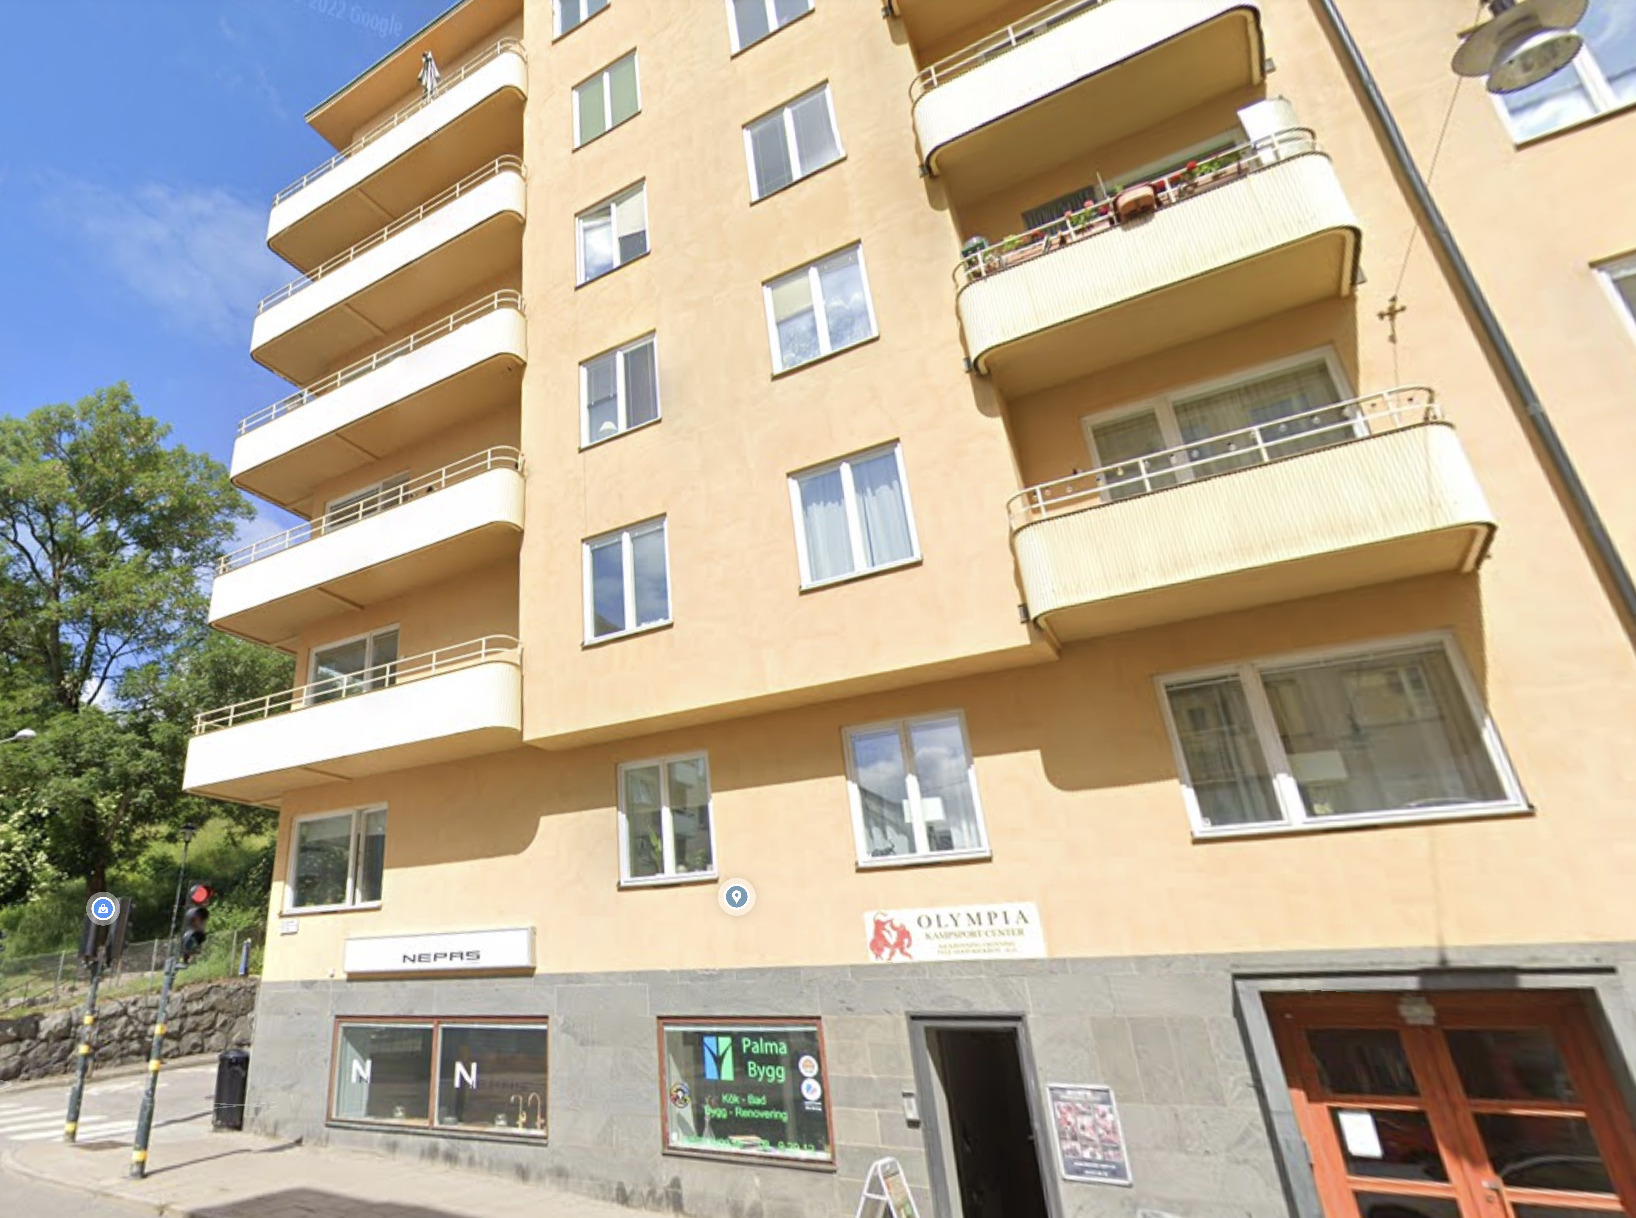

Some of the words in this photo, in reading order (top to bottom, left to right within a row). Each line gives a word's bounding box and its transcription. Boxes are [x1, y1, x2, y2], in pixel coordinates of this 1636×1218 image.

[916, 909, 1030, 929] OLYMPIA
[925, 931, 983, 940] KAMPSPORT
[984, 928, 1025, 937] CENTER
[402, 950, 481, 963] NEPAS
[741, 1037, 788, 1055] Palma
[351, 1058, 372, 1083] N
[454, 1061, 477, 1088] N
[747, 1061, 786, 1084] Bygg
[721, 1093, 740, 1104] Kök
[747, 1094, 767, 1105] Bad
[704, 1105, 728, 1119] Bygg
[735, 1107, 788, 1123] Renovering
